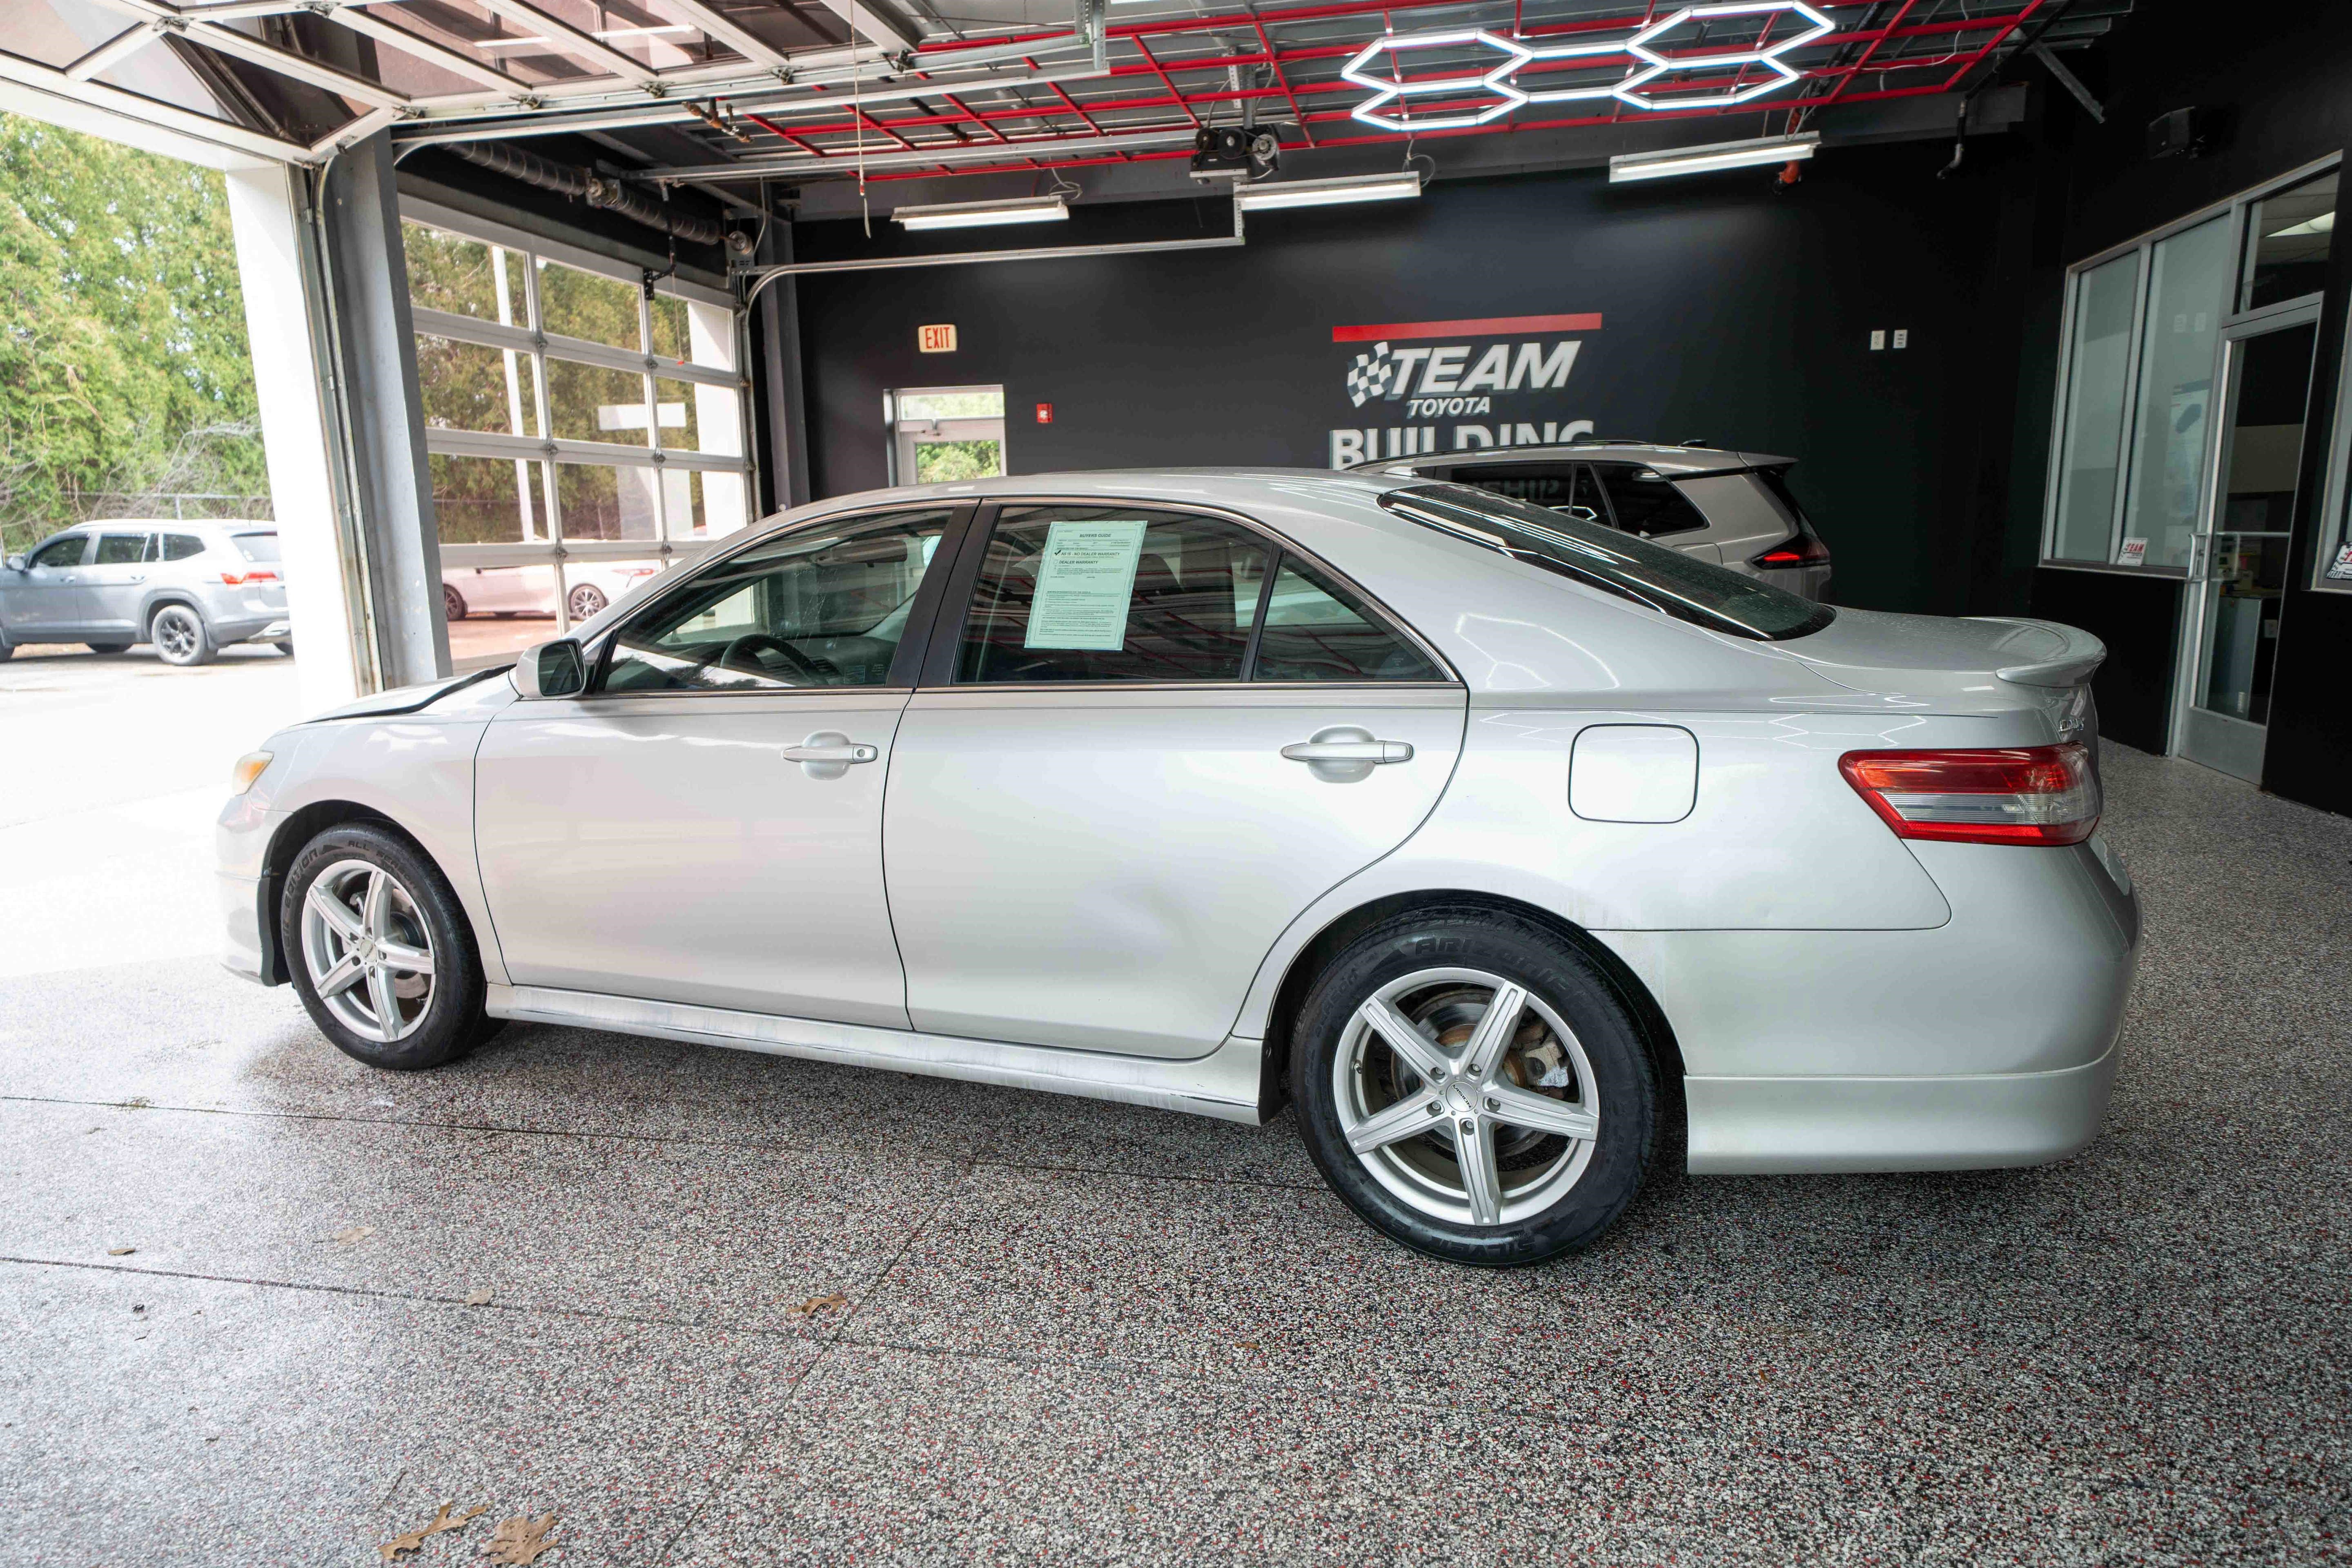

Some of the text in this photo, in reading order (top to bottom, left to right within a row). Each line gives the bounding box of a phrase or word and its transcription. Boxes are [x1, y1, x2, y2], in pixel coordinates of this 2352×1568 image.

[924, 327, 950, 349] EXIT
[1388, 340, 1582, 396] TEAM
[1407, 396, 1491, 417] TOYOTA
[1453, 1084, 1472, 1108] VISION
